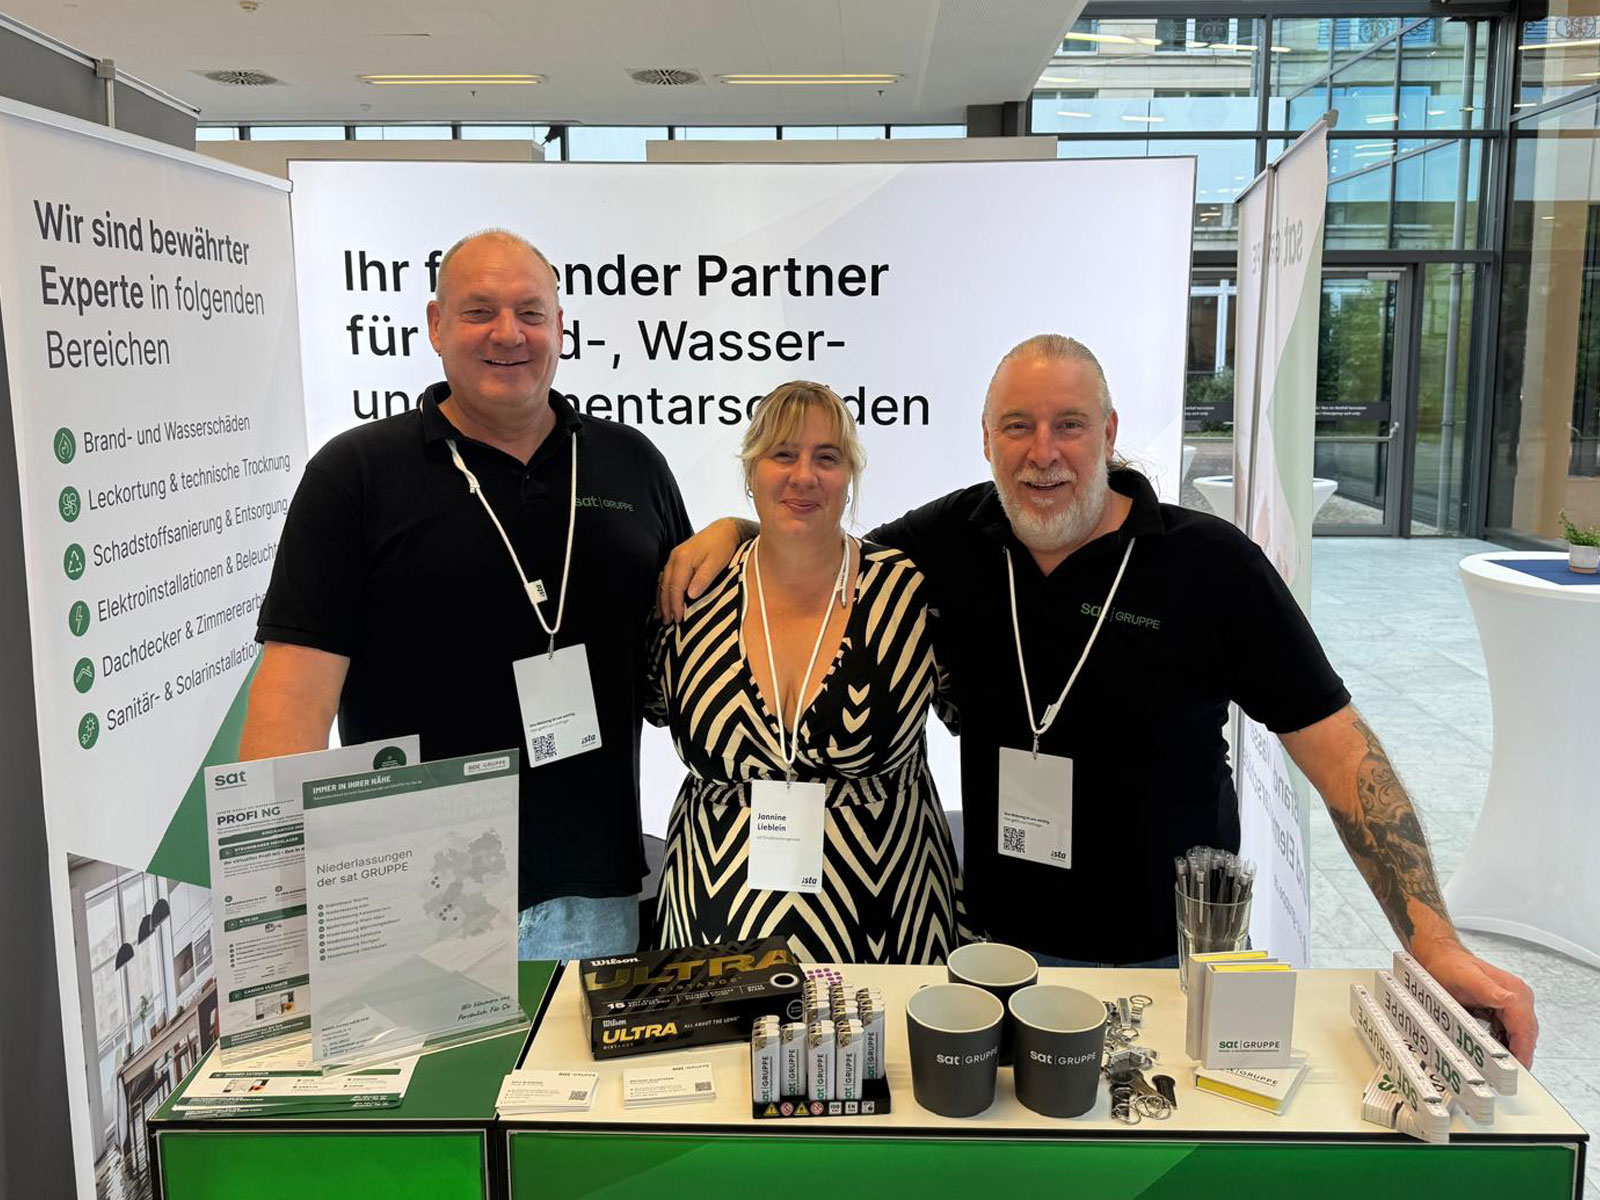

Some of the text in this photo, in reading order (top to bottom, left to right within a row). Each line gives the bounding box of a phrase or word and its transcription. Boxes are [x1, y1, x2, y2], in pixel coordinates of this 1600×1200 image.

[34, 200, 250, 265] Wir sind bewährter
[40, 265, 265, 321] Experte in folgenden
[344, 250, 409, 292] Ihr
[698, 255, 890, 297] Partner
[47, 330, 171, 369] Bereichen
[346, 314, 419, 356] für
[638, 320, 846, 361] Wasser-
[84, 414, 251, 454] Brand- und Wasserschäden
[88, 454, 291, 510] Leckortung & technische Trocknung
[603, 499, 635, 512] GRUPPE
[93, 498, 288, 567] Schadstoffsanierung & Entsorgung
[98, 562, 223, 623] Elektroinstallationen
[226, 556, 234, 575] &
[1115, 611, 1161, 630] GRUPPE
[102, 627, 182, 678] Dachdecker
[185, 620, 194, 640] &
[106, 690, 160, 732] Sanitär-
[165, 682, 173, 702] &
[214, 771, 246, 787] sat
[313, 783, 337, 795] IMMER
[347, 779, 370, 789] IHRER
[217, 810, 258, 826] PROFI
[261, 806, 281, 818] NG
[757, 823, 787, 832] Lieblein
[758, 813, 787, 822] Jannine
[316, 849, 413, 875] Niederlassungen
[316, 861, 409, 888] der sat GRUPPE
[584, 949, 796, 991] ULTRA
[590, 956, 641, 967] Wilson
[603, 1022, 678, 1044] ULTRA
[1357, 1005, 1393, 1072] GRUPPE
[1384, 991, 1429, 1055] GRUPPE
[1405, 971, 1485, 1068] sat GRUPPE
[788, 1049, 796, 1079] GRUPPE
[936, 1054, 960, 1065] sat
[1029, 1050, 1096, 1065] sat GRUPPE
[1219, 1040, 1280, 1049] sat GRUPPE
[1397, 1065, 1418, 1112] sat
[1434, 1049, 1461, 1095] sat
